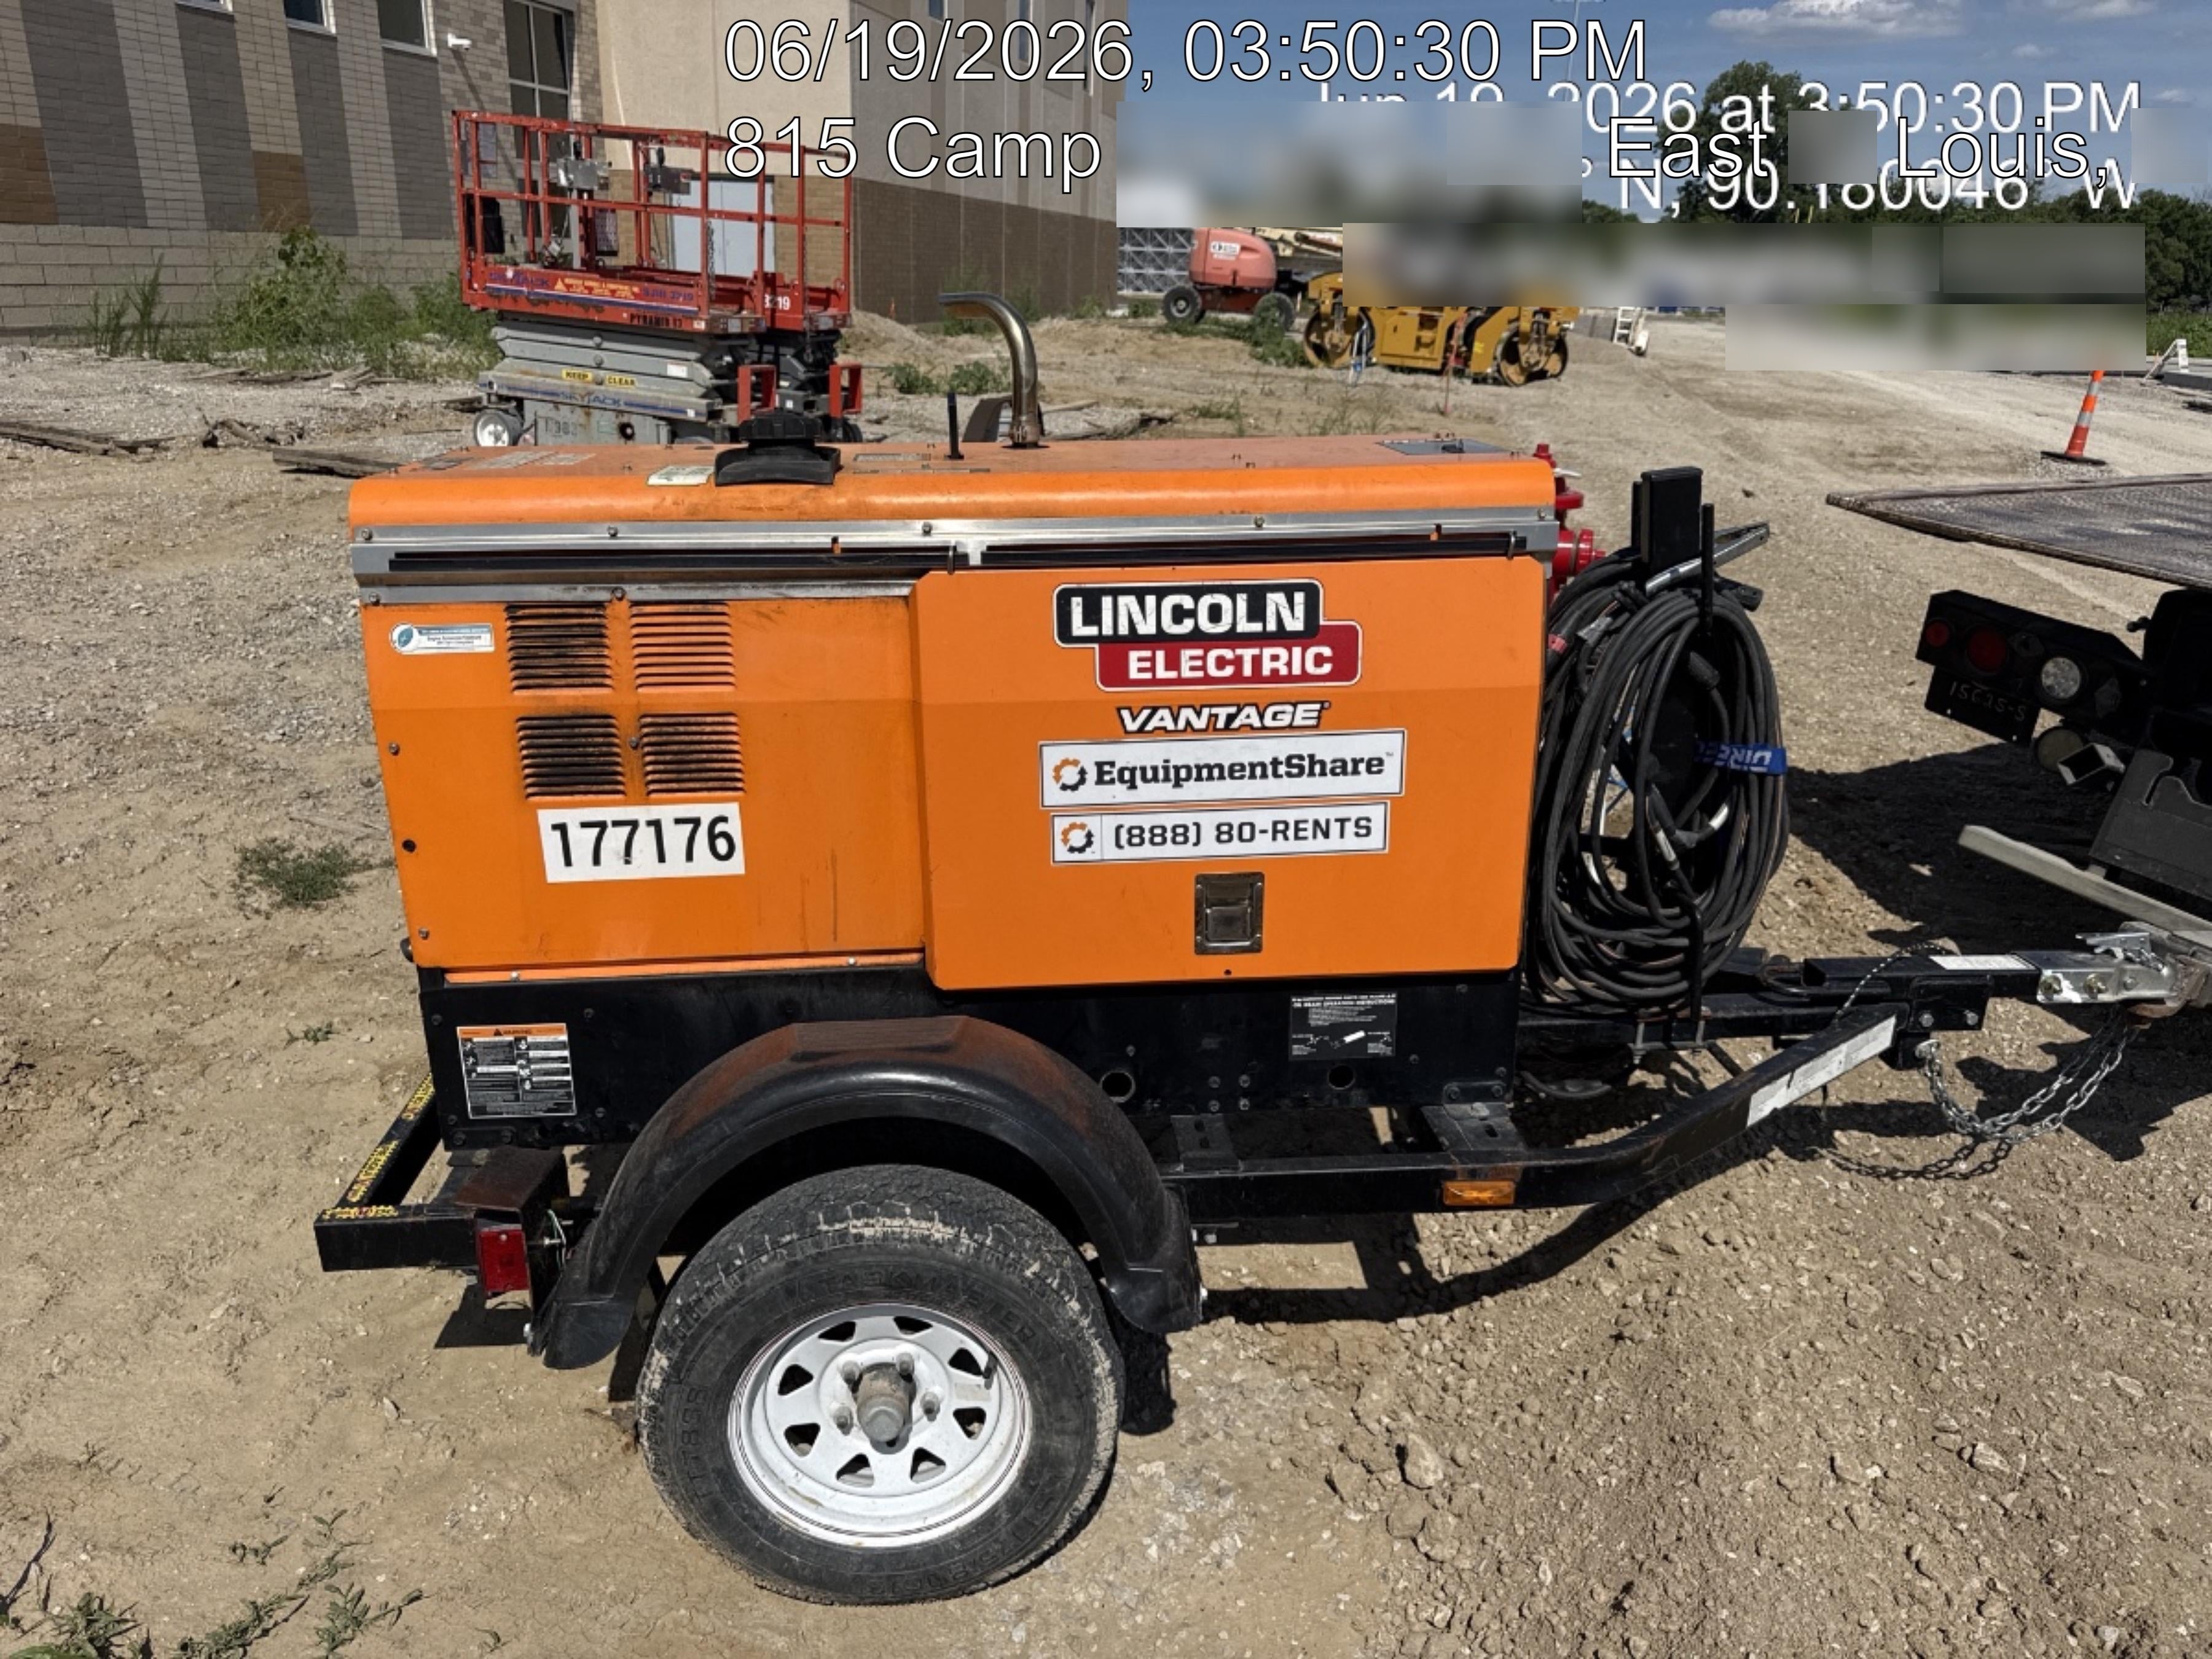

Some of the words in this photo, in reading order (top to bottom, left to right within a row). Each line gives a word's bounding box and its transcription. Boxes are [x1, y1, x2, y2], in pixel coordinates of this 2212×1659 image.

[1070, 591, 1305, 637] LINCOLN
[1128, 645, 1333, 680] ELECTRIC
[1118, 701, 1322, 732] VANTAGE
[1094, 753, 1386, 790] EquipmentShare
[551, 815, 736, 867] 177176
[1115, 822, 1201, 849] (888)
[1215, 816, 1373, 844] 80-RENTS
